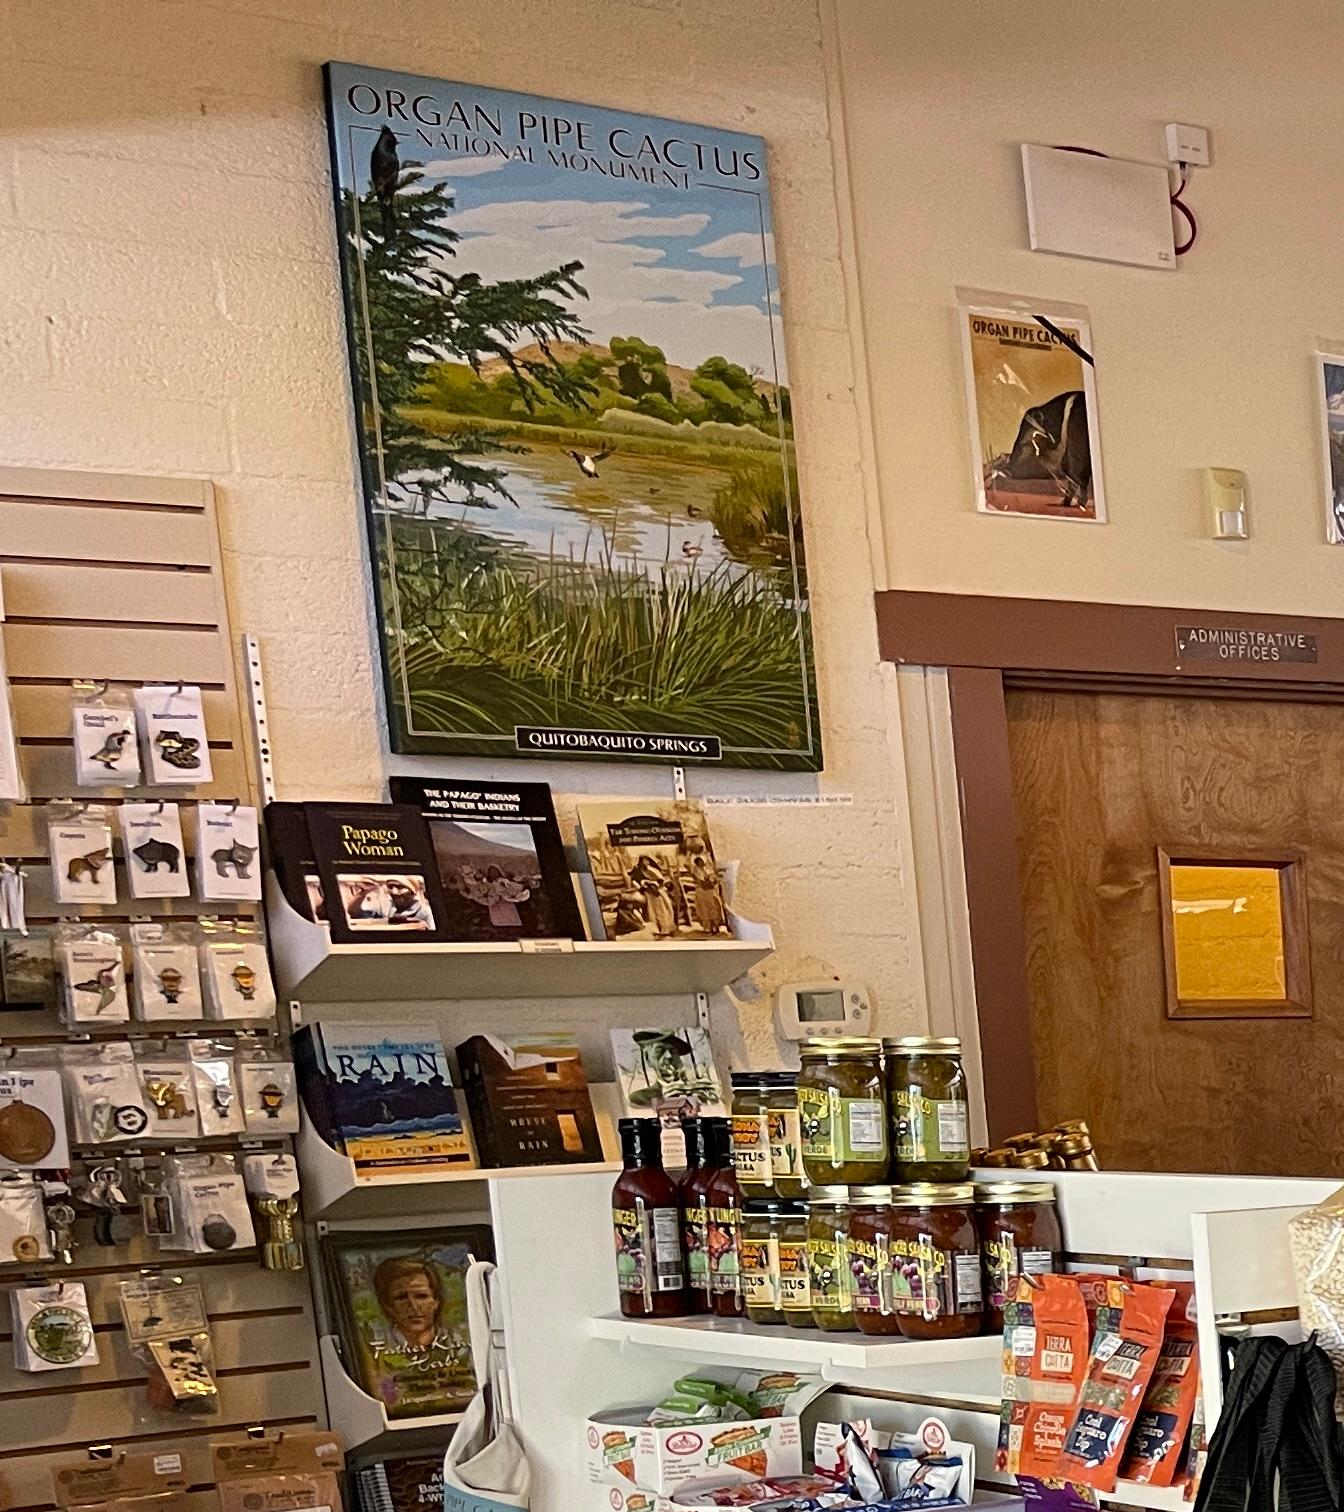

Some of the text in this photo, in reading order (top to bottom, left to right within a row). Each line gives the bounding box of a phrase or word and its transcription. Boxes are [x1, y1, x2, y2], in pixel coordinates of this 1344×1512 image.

[347, 83, 762, 183] ORGAN PIPE CACTUS
[415, 129, 692, 190] NATIONAL MONUMENT
[973, 320, 1076, 345] ORGAN PIPE CACS
[1188, 629, 1306, 649] ADMINISTRATIVE
[1219, 644, 1280, 661] OFFICES
[528, 731, 708, 755] QUITOBAQUITO SPRINGS
[342, 825, 398, 845] Papago
[343, 841, 404, 857] Woman
[337, 1052, 440, 1077] RAIN
[1046, 1335, 1072, 1352] TERRA
[1121, 1341, 1146, 1359] TERRA
[1044, 1353, 1071, 1369] COTTA
[1106, 1357, 1134, 1375] COTTA
